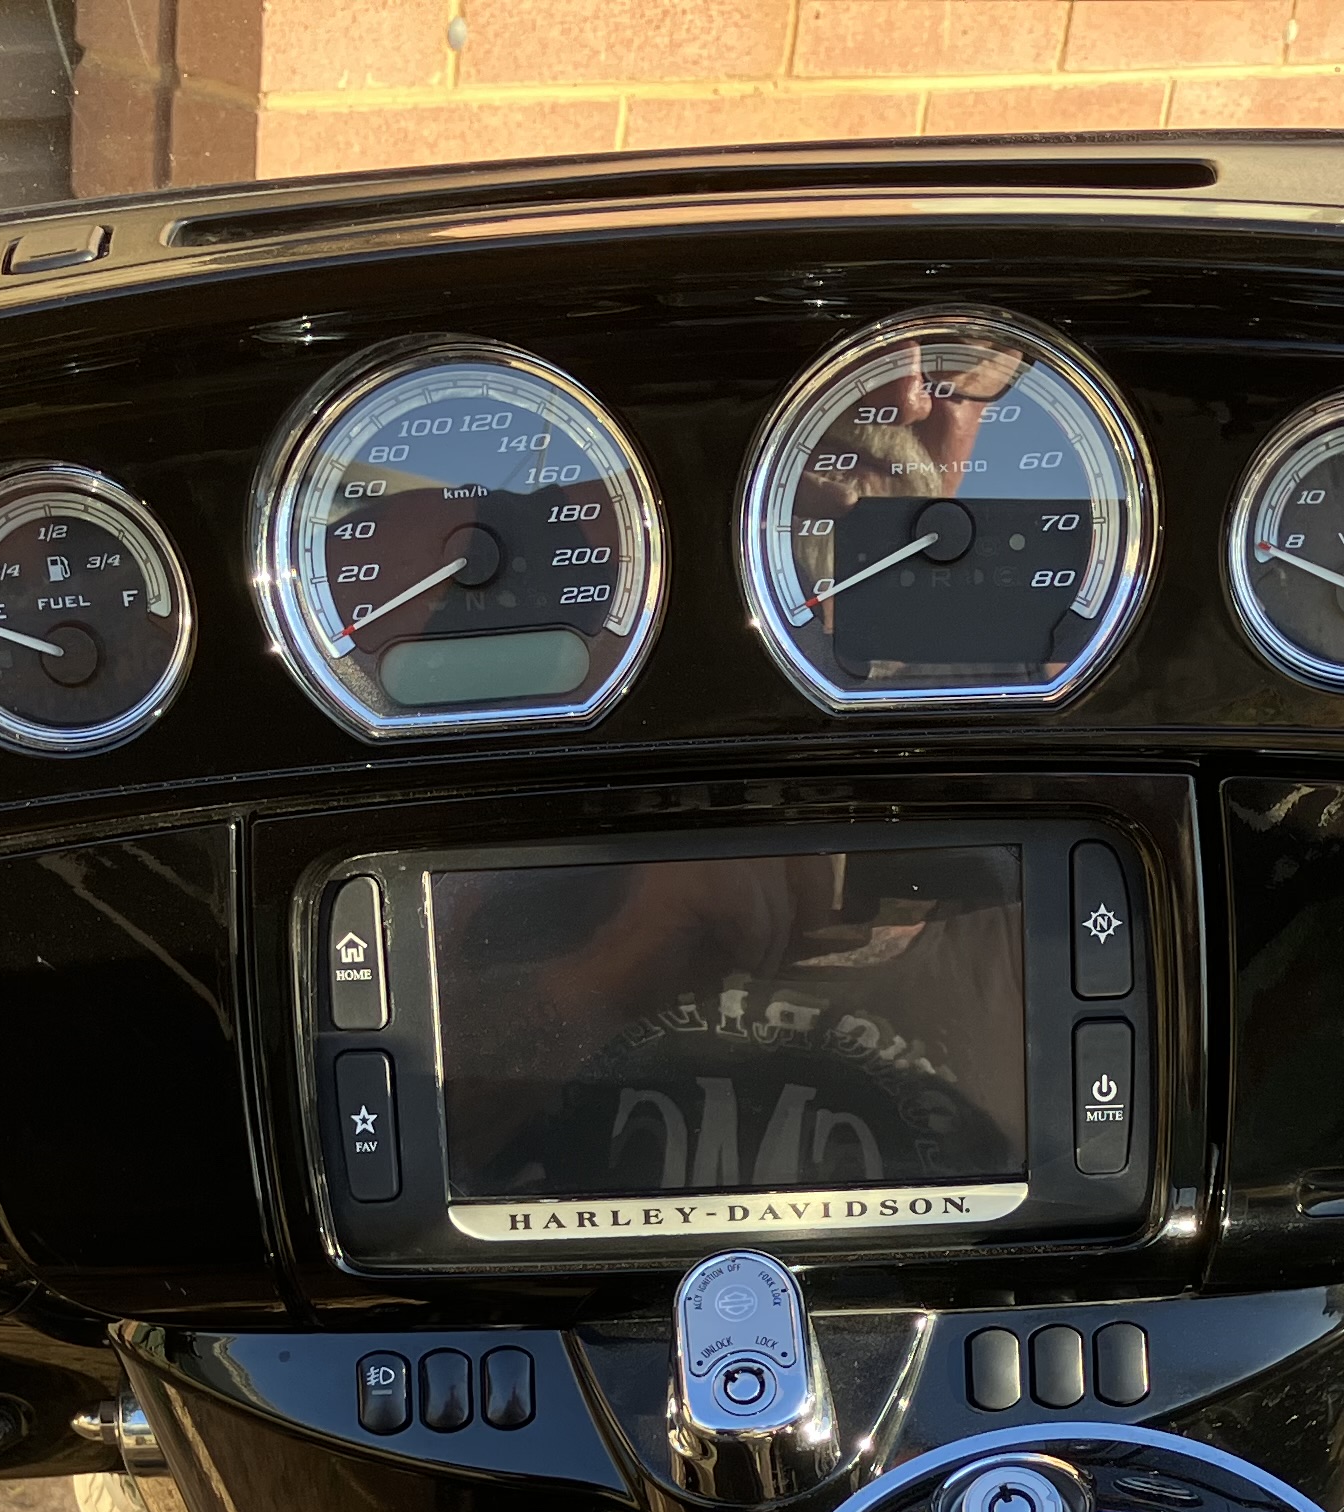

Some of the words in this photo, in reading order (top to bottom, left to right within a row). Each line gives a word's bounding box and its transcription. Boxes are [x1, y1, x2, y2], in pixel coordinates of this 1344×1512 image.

[921, 381, 956, 398] 40
[459, 412, 513, 431] 120
[854, 406, 898, 424] 30
[977, 406, 1021, 424] 50
[398, 417, 452, 437] 100
[497, 433, 551, 453] 140
[368, 445, 409, 463] 80
[814, 453, 858, 471] 20
[1019, 452, 1062, 470] 60
[525, 464, 581, 484] 160
[344, 480, 387, 498] 60
[443, 486, 488, 499] km/h
[1296, 489, 1326, 505] 10
[548, 503, 601, 523] 180
[334, 521, 376, 540] 40
[798, 519, 834, 536] 10
[1041, 514, 1080, 531] 70
[37, 524, 68, 543] 1/2
[1284, 534, 1305, 549] 8
[86, 554, 121, 571] 3/4
[551, 547, 611, 566] 200
[337, 564, 380, 583] 20
[1031, 570, 1076, 588] 80
[560, 584, 610, 604] 220
[813, 578, 835, 595] 0
[37, 595, 91, 610] FUEL
[122, 590, 138, 607] F
[352, 604, 373, 621] 0
[336, 969, 372, 981] HOME
[1086, 1110, 1123, 1122] MUTE
[355, 1141, 378, 1153] FAV
[726, 1263, 741, 1273] OFF
[697, 1267, 724, 1293] IGNITION
[757, 1270, 776, 1289] FORK
[770, 1288, 782, 1307] LOCK
[700, 1336, 734, 1359] UNLOCK
[755, 1336, 779, 1350] LOCK
